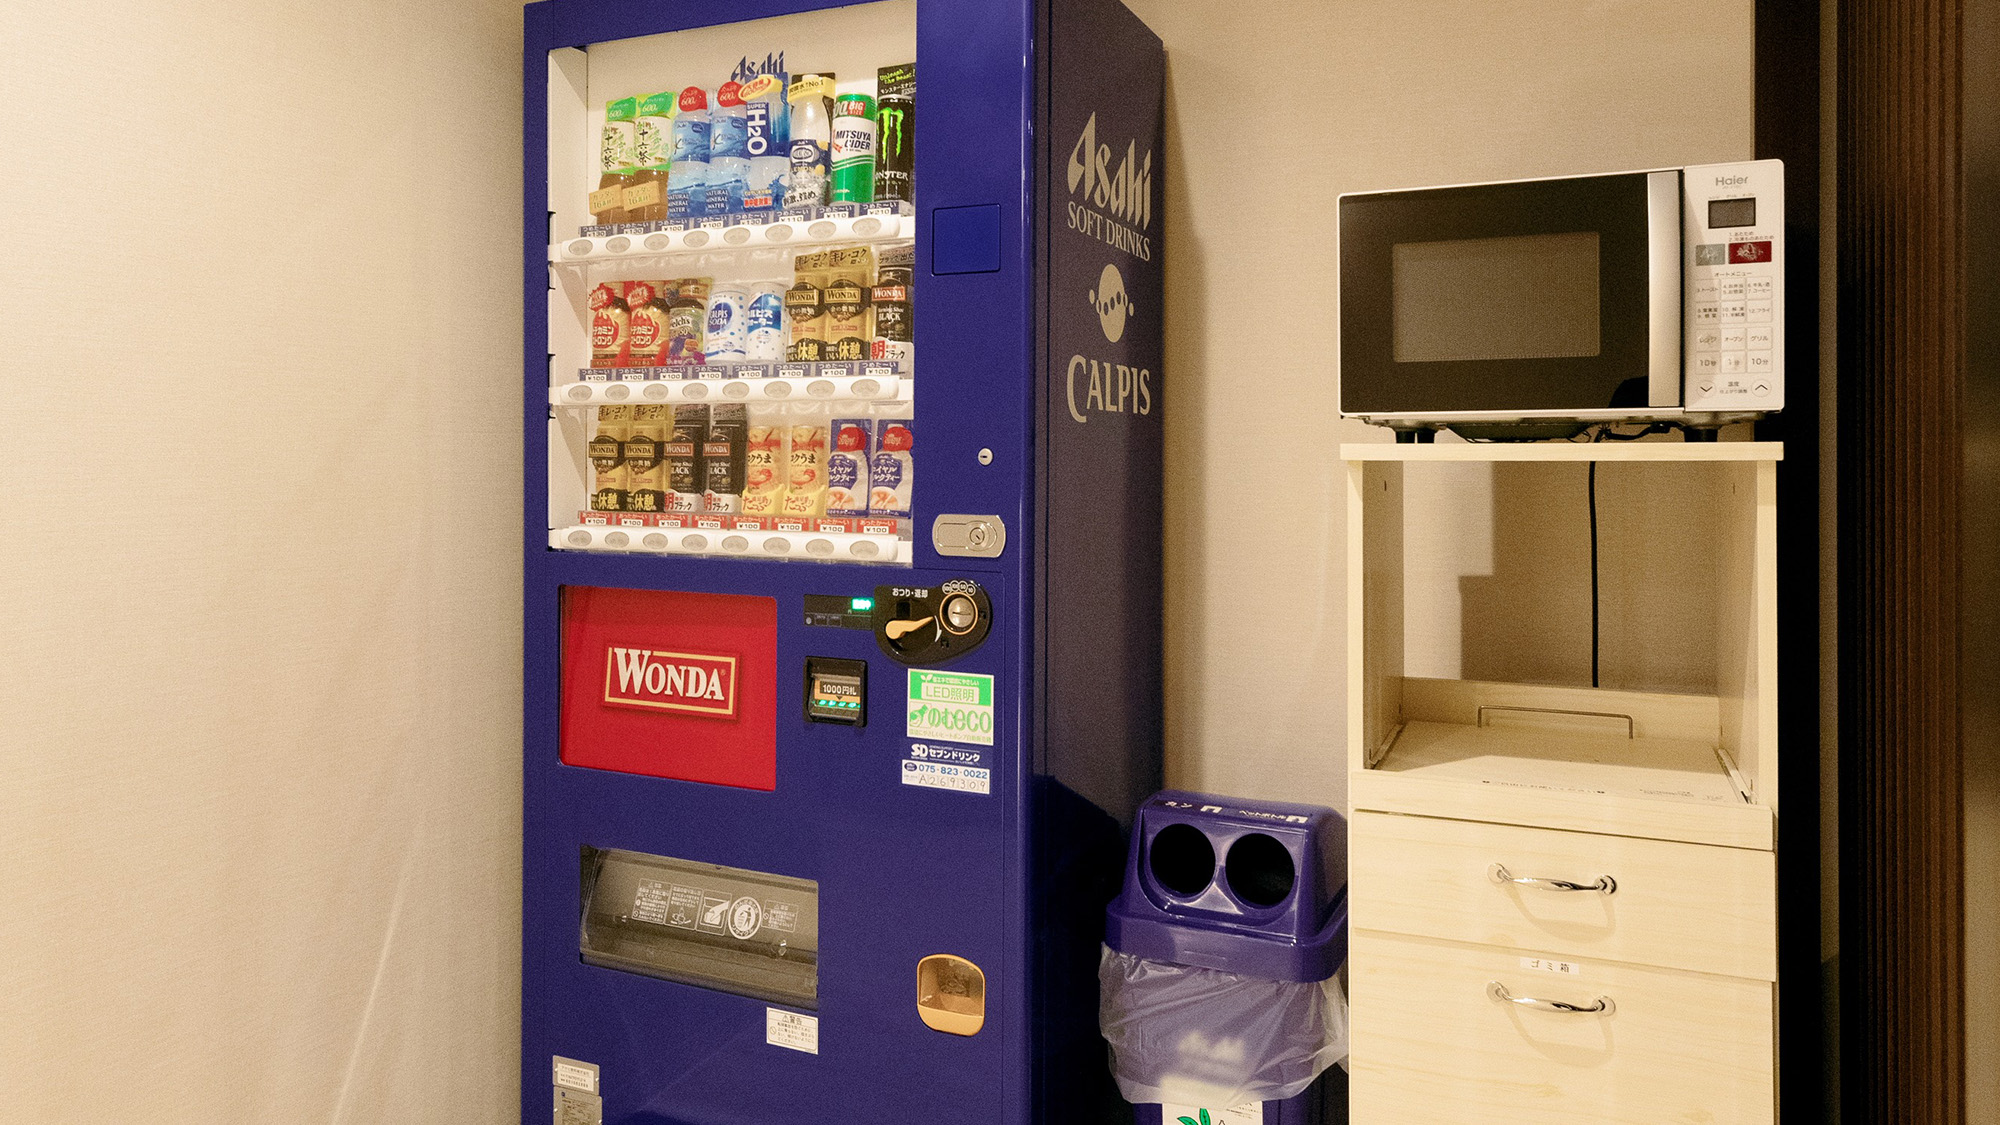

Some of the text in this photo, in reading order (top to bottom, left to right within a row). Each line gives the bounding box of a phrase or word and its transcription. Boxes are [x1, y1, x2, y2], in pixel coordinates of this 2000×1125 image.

[731, 50, 784, 81] Asahi
[848, 102, 863, 110] BIG
[836, 130, 871, 142] MITSUYA
[844, 140, 870, 150] CIDER
[1067, 110, 1150, 230] Asahi
[1716, 176, 1748, 186] Haier
[1067, 201, 1150, 262] SOFT DRINKS
[788, 292, 815, 302] WONDA
[828, 290, 858, 300] WONDA
[874, 288, 902, 298] WONDA
[748, 309, 773, 318] ルピス
[878, 312, 900, 322] BLACK
[748, 318, 773, 326] ォーター
[871, 340, 886, 360] 朝
[1066, 354, 1150, 423] CALPIS
[590, 444, 615, 454] WONDA
[626, 444, 652, 454] WONDA
[666, 444, 690, 454] WONDA
[704, 443, 728, 453] WONDA
[672, 466, 690, 475] LACK
[710, 466, 727, 475] LACK
[830, 474, 855, 482] クティー
[874, 474, 900, 482] クティー
[598, 492, 618, 510] 休憩
[634, 494, 655, 511] 休憩
[674, 502, 692, 510] ブラック
[712, 502, 730, 512] ブラック
[892, 588, 928, 598] おつり・返却
[614, 648, 724, 700] WONDA
[822, 684, 856, 696] 1000円札
[926, 686, 974, 702] LED照明
[928, 708, 992, 734] のむeco
[910, 743, 928, 758] SD
[928, 748, 980, 762] セブンドリンク
